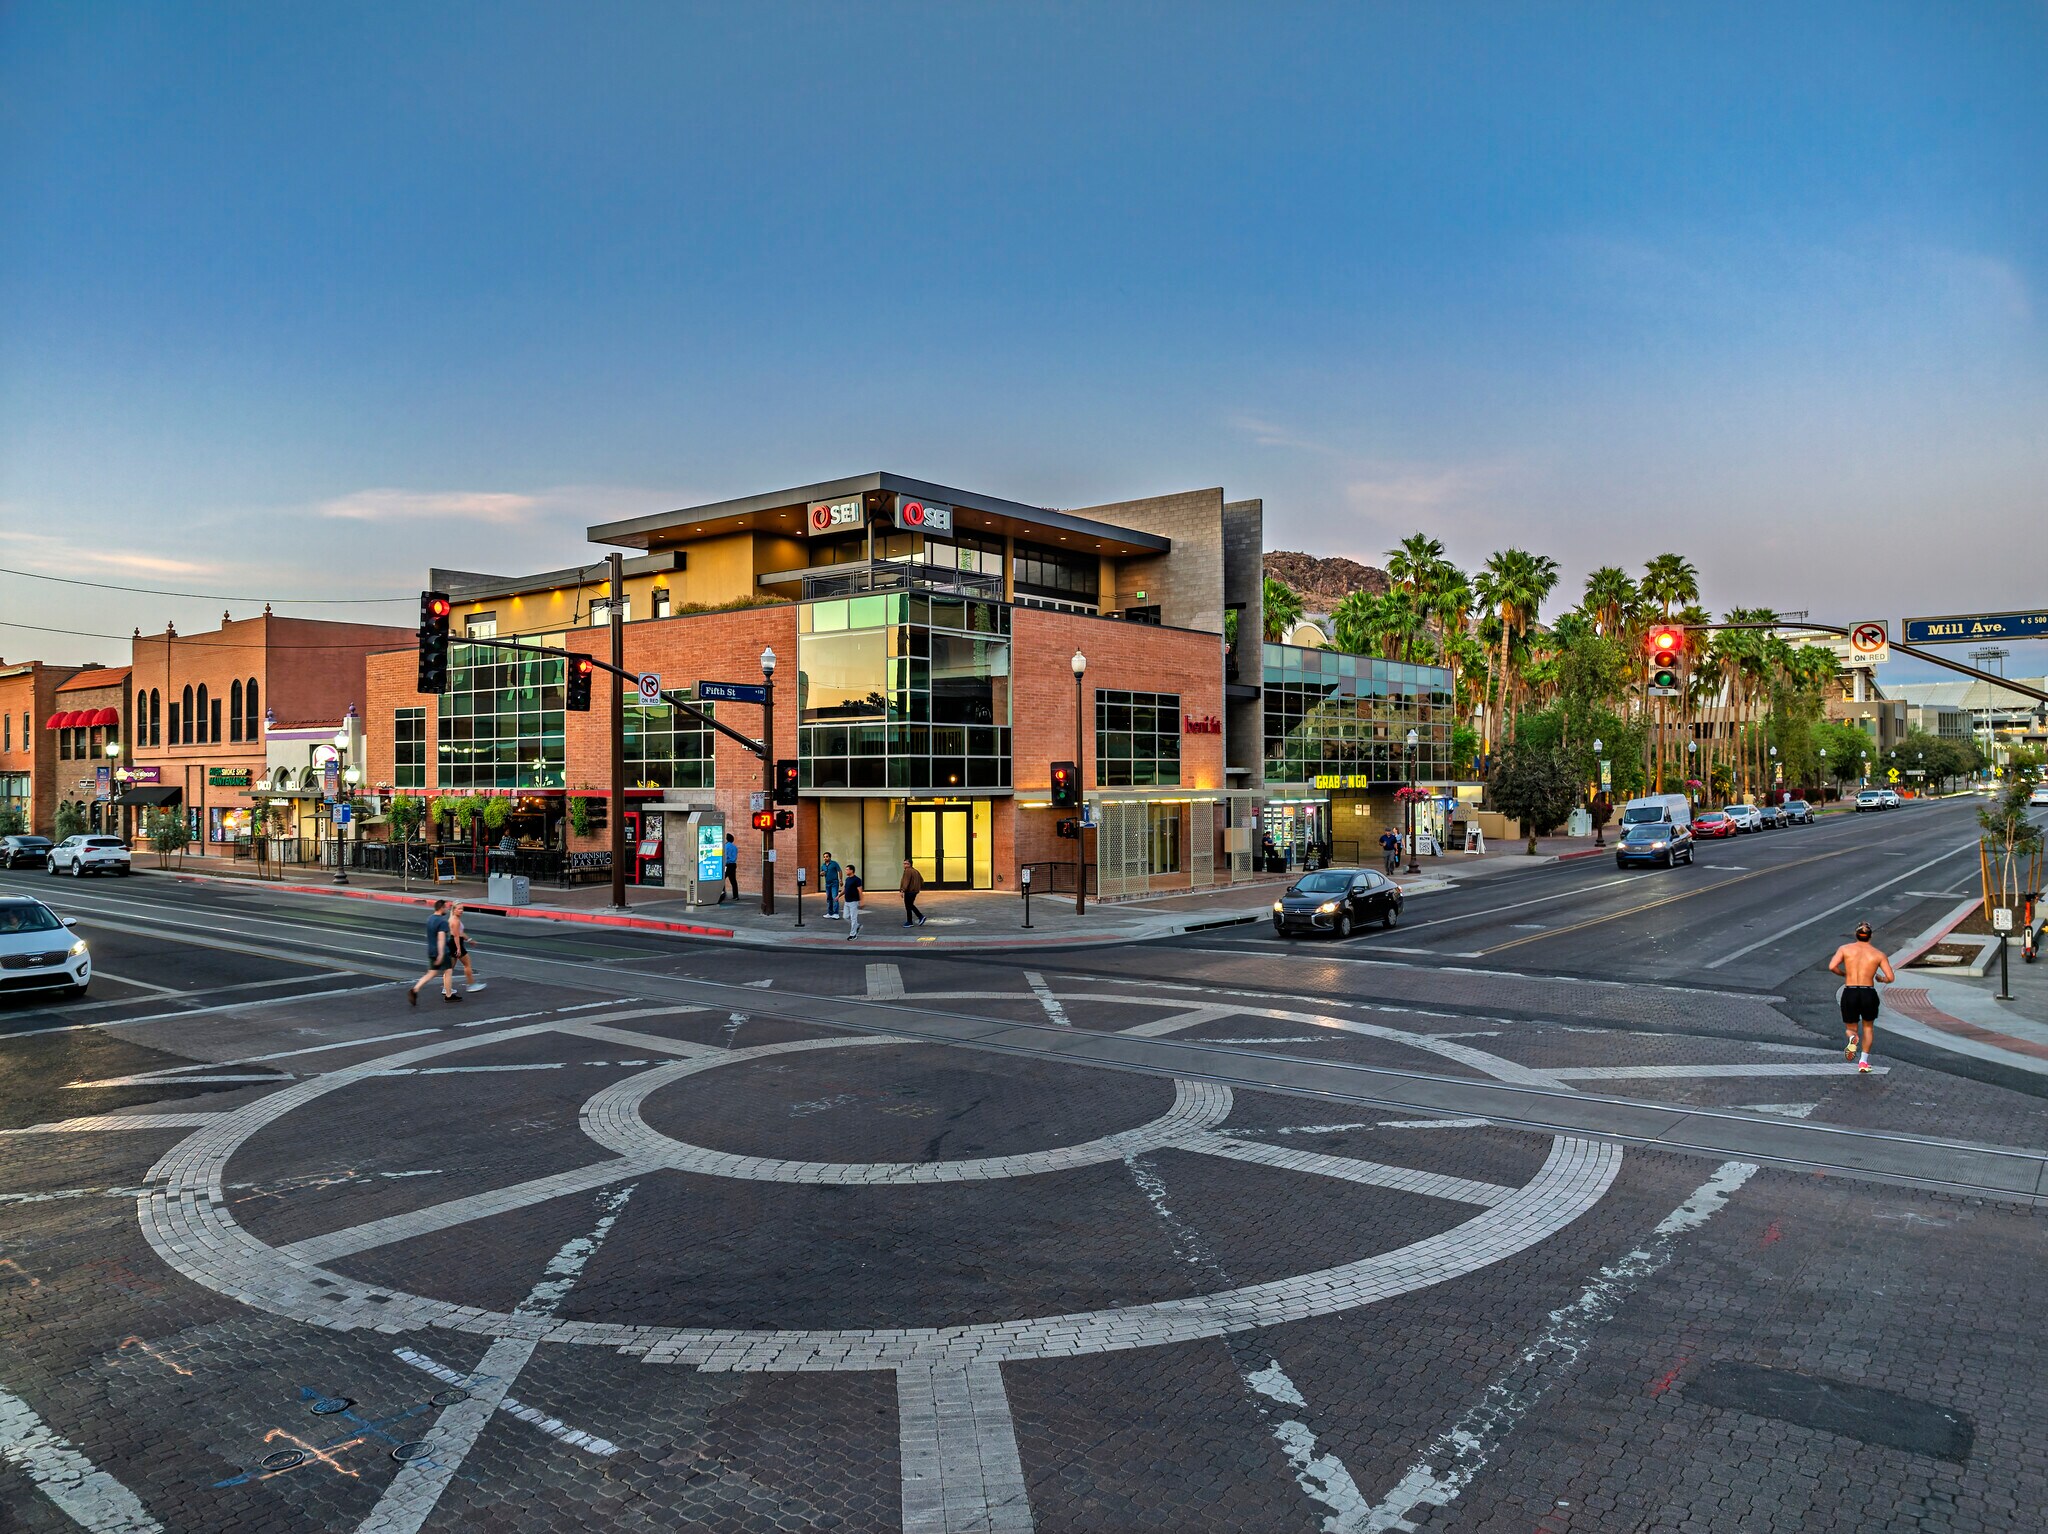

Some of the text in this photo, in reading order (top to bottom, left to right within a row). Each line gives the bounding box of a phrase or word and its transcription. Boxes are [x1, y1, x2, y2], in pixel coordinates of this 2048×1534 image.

[830, 503, 859, 524] SEI
[923, 507, 950, 530] SEI
[1927, 623, 1964, 635] Mill
[1970, 622, 2006, 633] Ave.
[2034, 616, 2047, 624] 500
[705, 686, 736, 696] Fifth St
[221, 768, 235, 776] SMOKE
[236, 768, 247, 776] SHOP
[209, 777, 247, 786] MAINTENANCE
[256, 781, 300, 790] TACO BELL
[1315, 775, 1340, 789] GRAB
[1355, 775, 1367, 788] GO
[760, 815, 770, 827] 27
[573, 851, 605, 860] CORNISH
[574, 858, 604, 866] PASTY
